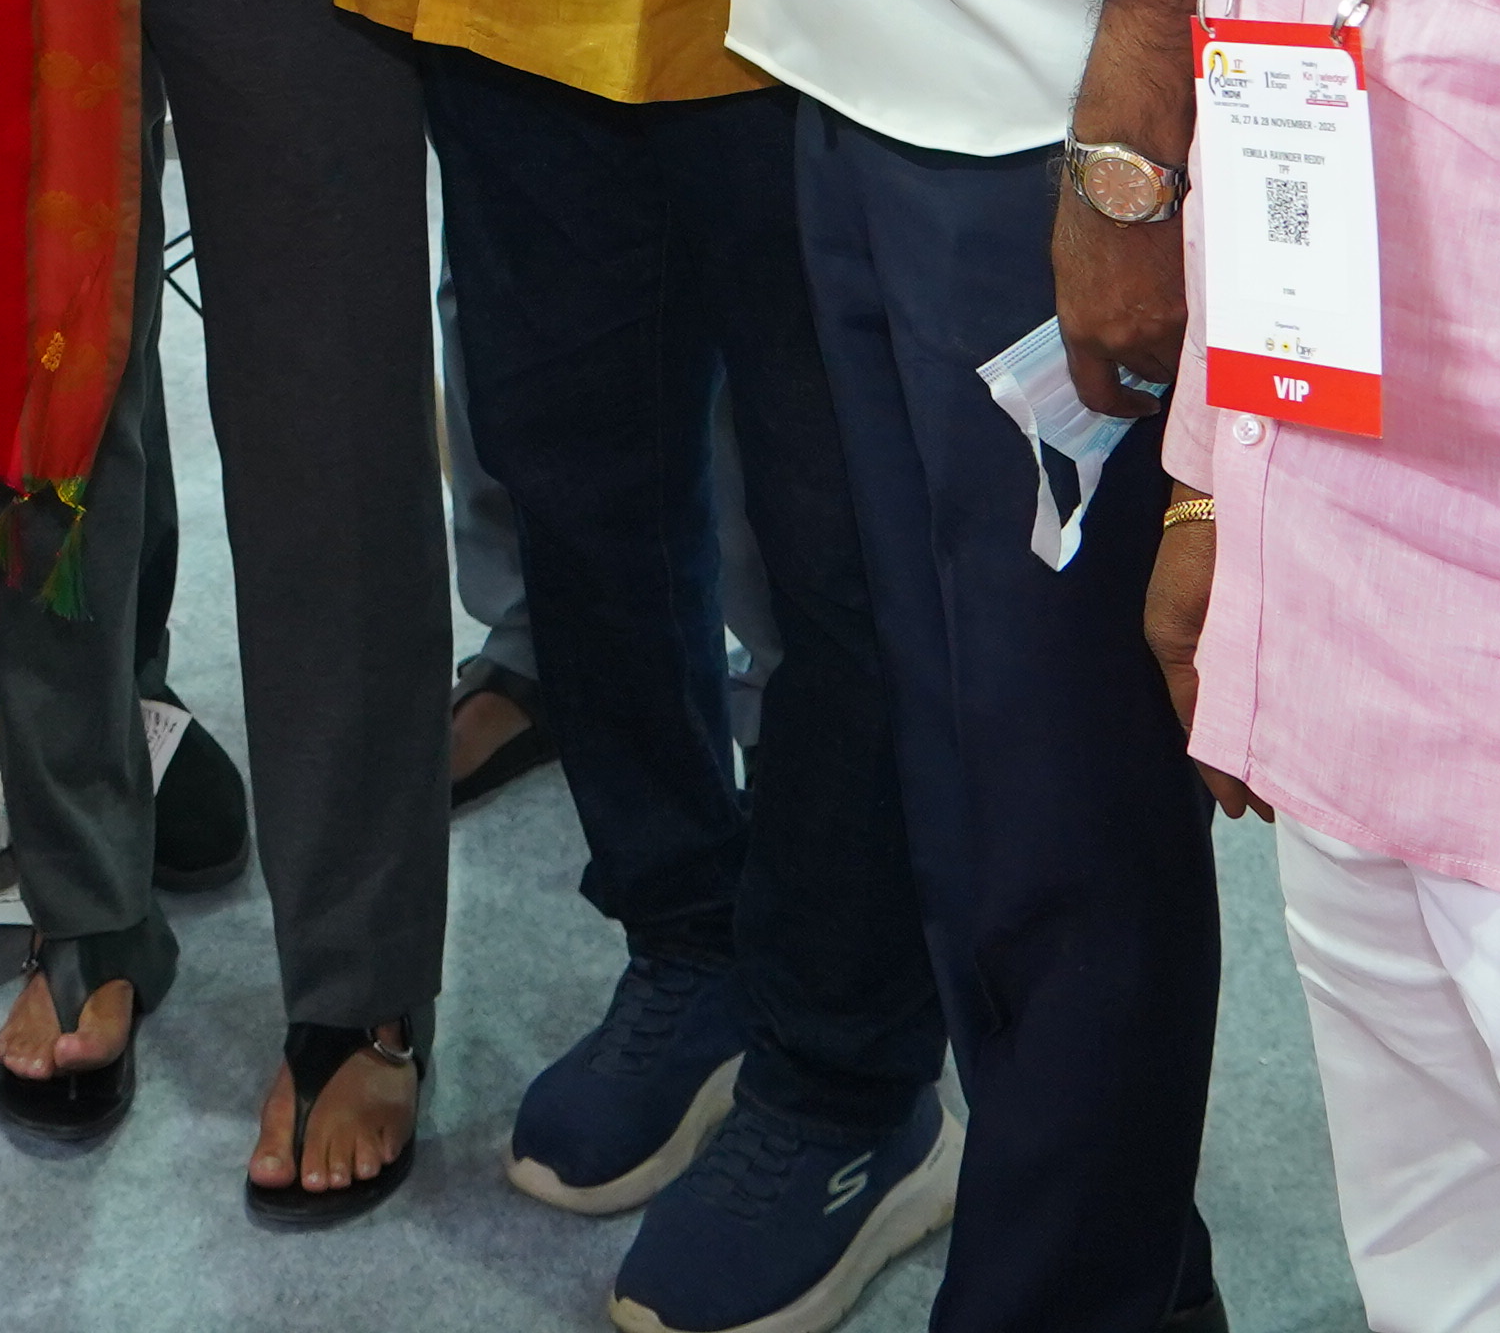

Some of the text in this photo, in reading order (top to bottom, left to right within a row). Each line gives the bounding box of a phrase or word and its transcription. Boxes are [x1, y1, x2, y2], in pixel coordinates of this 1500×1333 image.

[1243, 116, 1251, 124] 27
[1271, 118, 1312, 130] NOVEMBER
[1318, 122, 1336, 132] 2025
[1273, 375, 1310, 403] VIP
